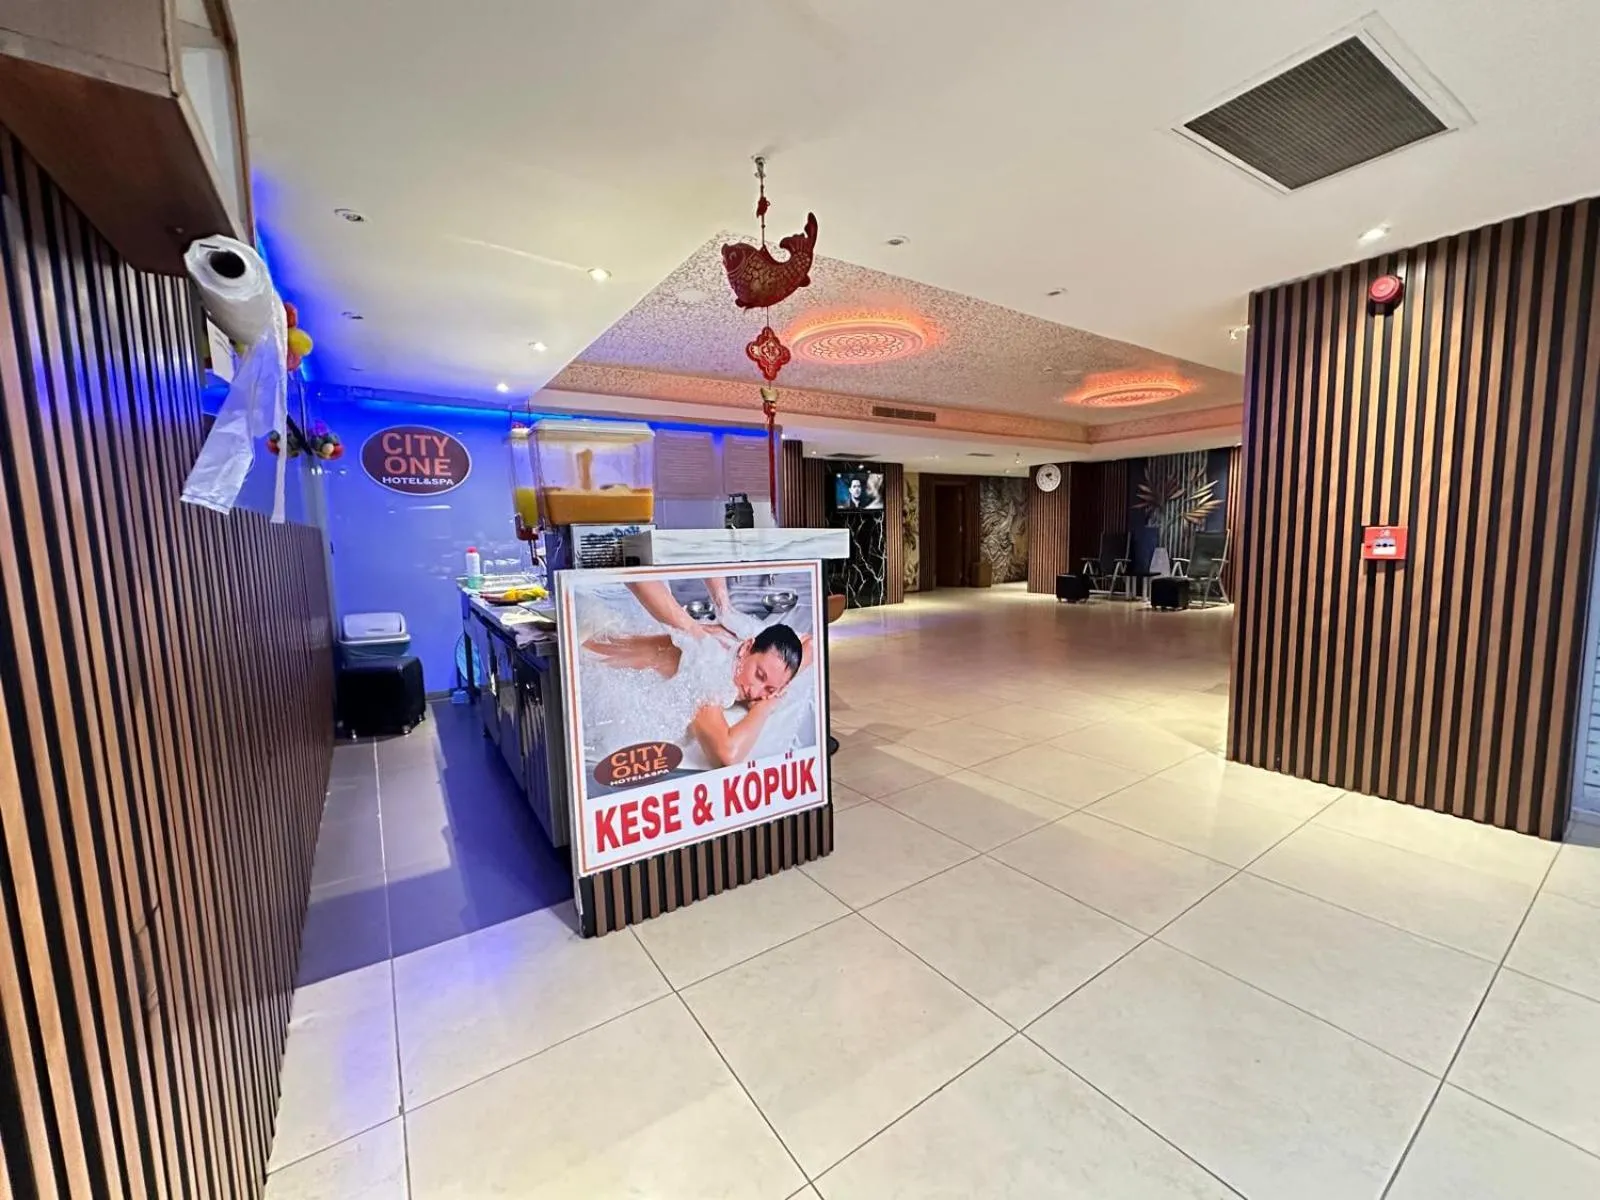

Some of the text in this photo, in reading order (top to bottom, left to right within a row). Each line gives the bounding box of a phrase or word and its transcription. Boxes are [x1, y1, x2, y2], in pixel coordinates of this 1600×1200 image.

[382, 432, 449, 456] CITY
[384, 456, 452, 476] ONE
[382, 476, 454, 485] HOTEL&SPA
[610, 743, 667, 767] CITY
[610, 768, 670, 786] HOTEL&SPA
[612, 757, 668, 779] ONE
[595, 753, 817, 853] KESE & KÖPÜK
